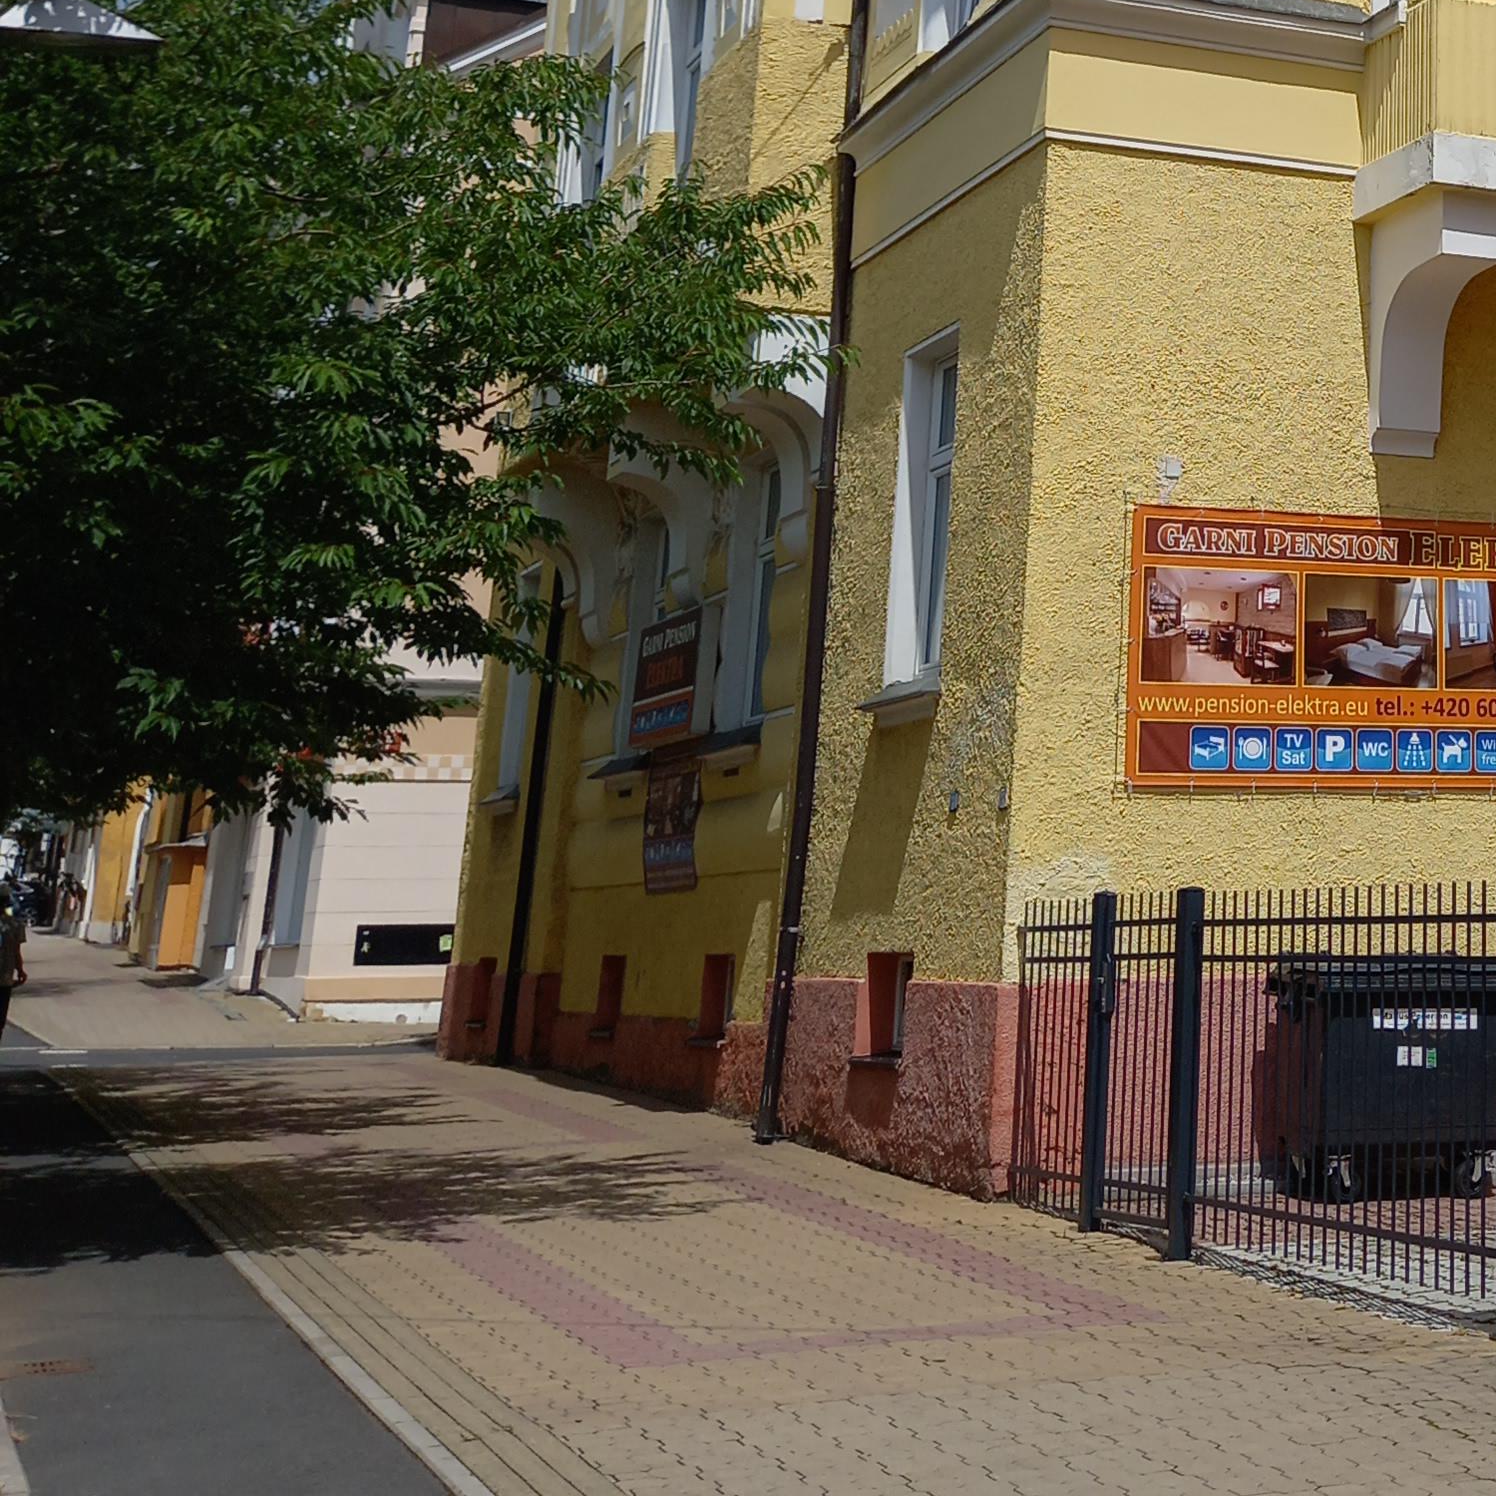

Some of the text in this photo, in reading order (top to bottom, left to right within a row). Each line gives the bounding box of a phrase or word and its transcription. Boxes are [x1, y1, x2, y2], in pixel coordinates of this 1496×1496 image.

[1157, 523, 1256, 555] GARNI
[1264, 527, 1399, 562] PENSION
[1138, 694, 1369, 717] www.pension-elektra.eu
[1375, 696, 1416, 717] tel.:
[1421, 697, 1470, 718] +420
[1284, 733, 1303, 748] TV
[1324, 735, 1345, 762] P
[1362, 741, 1389, 758] WC
[1281, 750, 1305, 766] Sat
